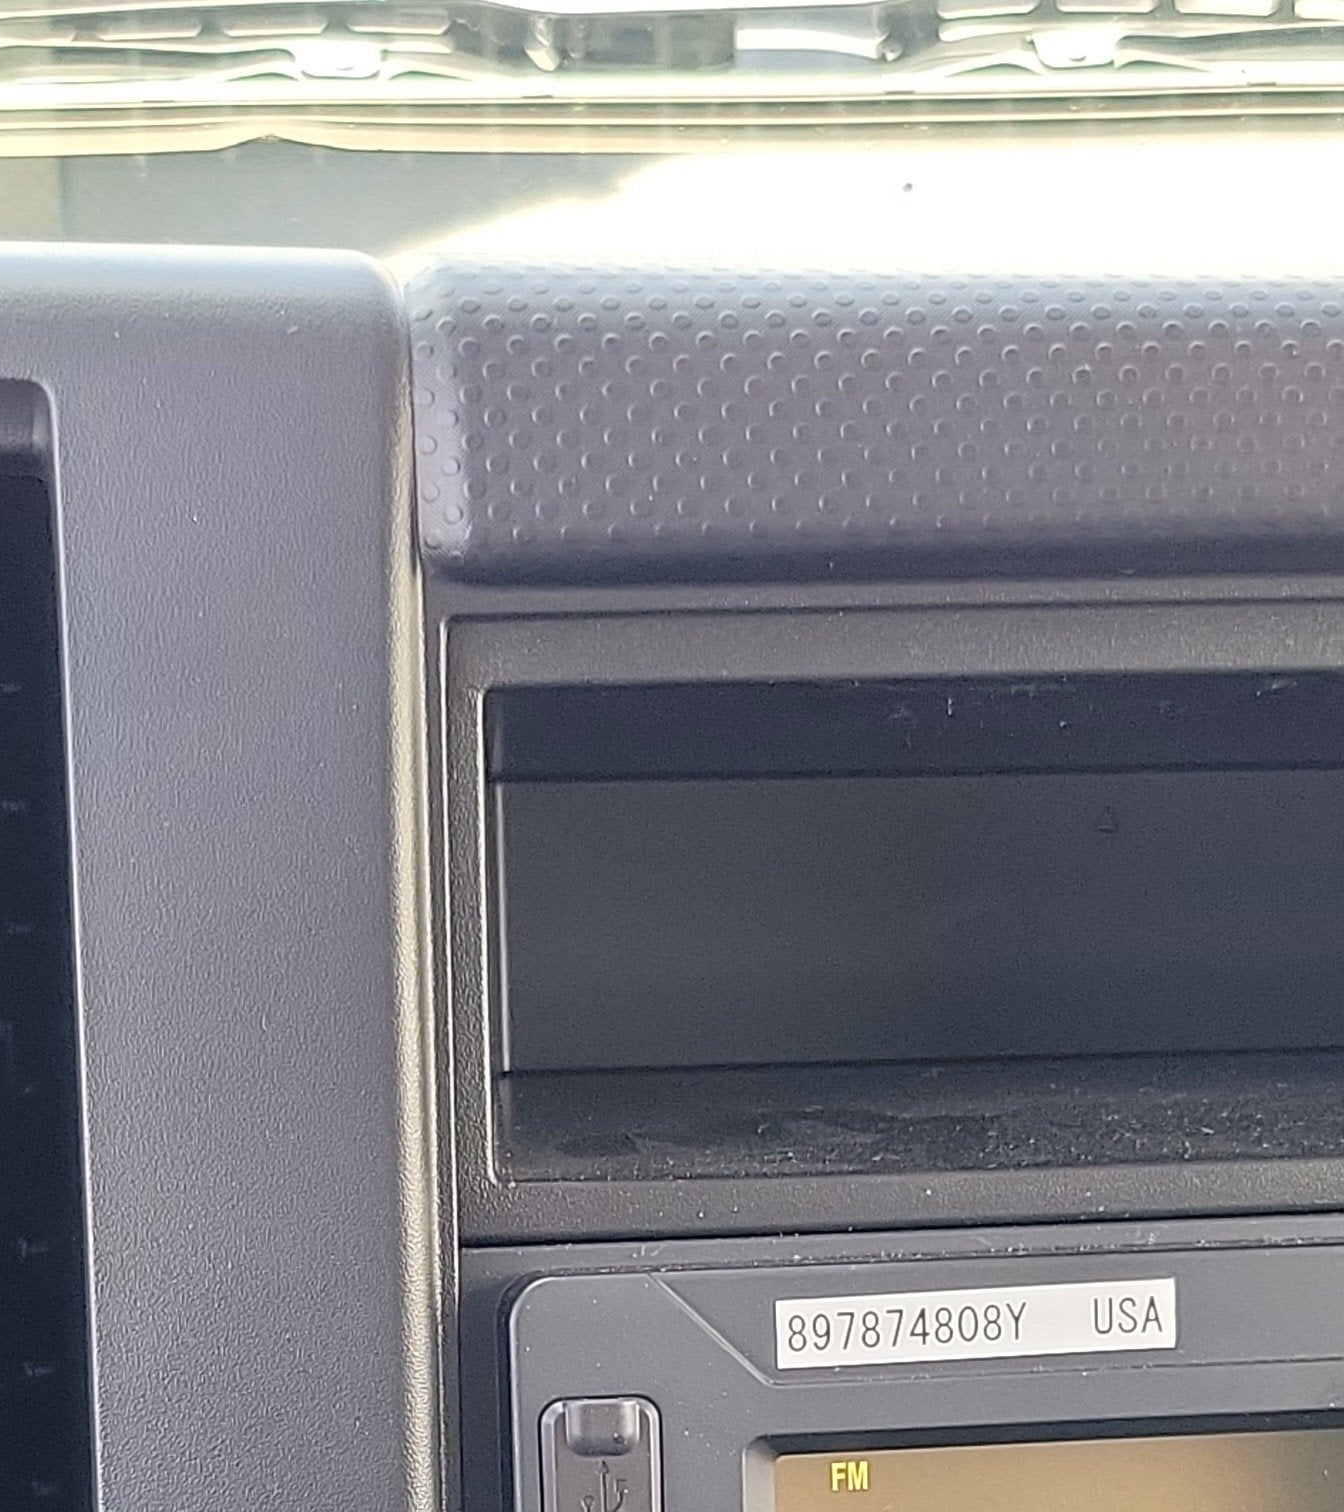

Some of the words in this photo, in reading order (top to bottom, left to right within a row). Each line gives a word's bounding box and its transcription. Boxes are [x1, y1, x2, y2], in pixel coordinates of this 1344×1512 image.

[786, 1300, 1027, 1353] 897874808Y
[1092, 1296, 1163, 1337] USA
[831, 1461, 869, 1491] FM
